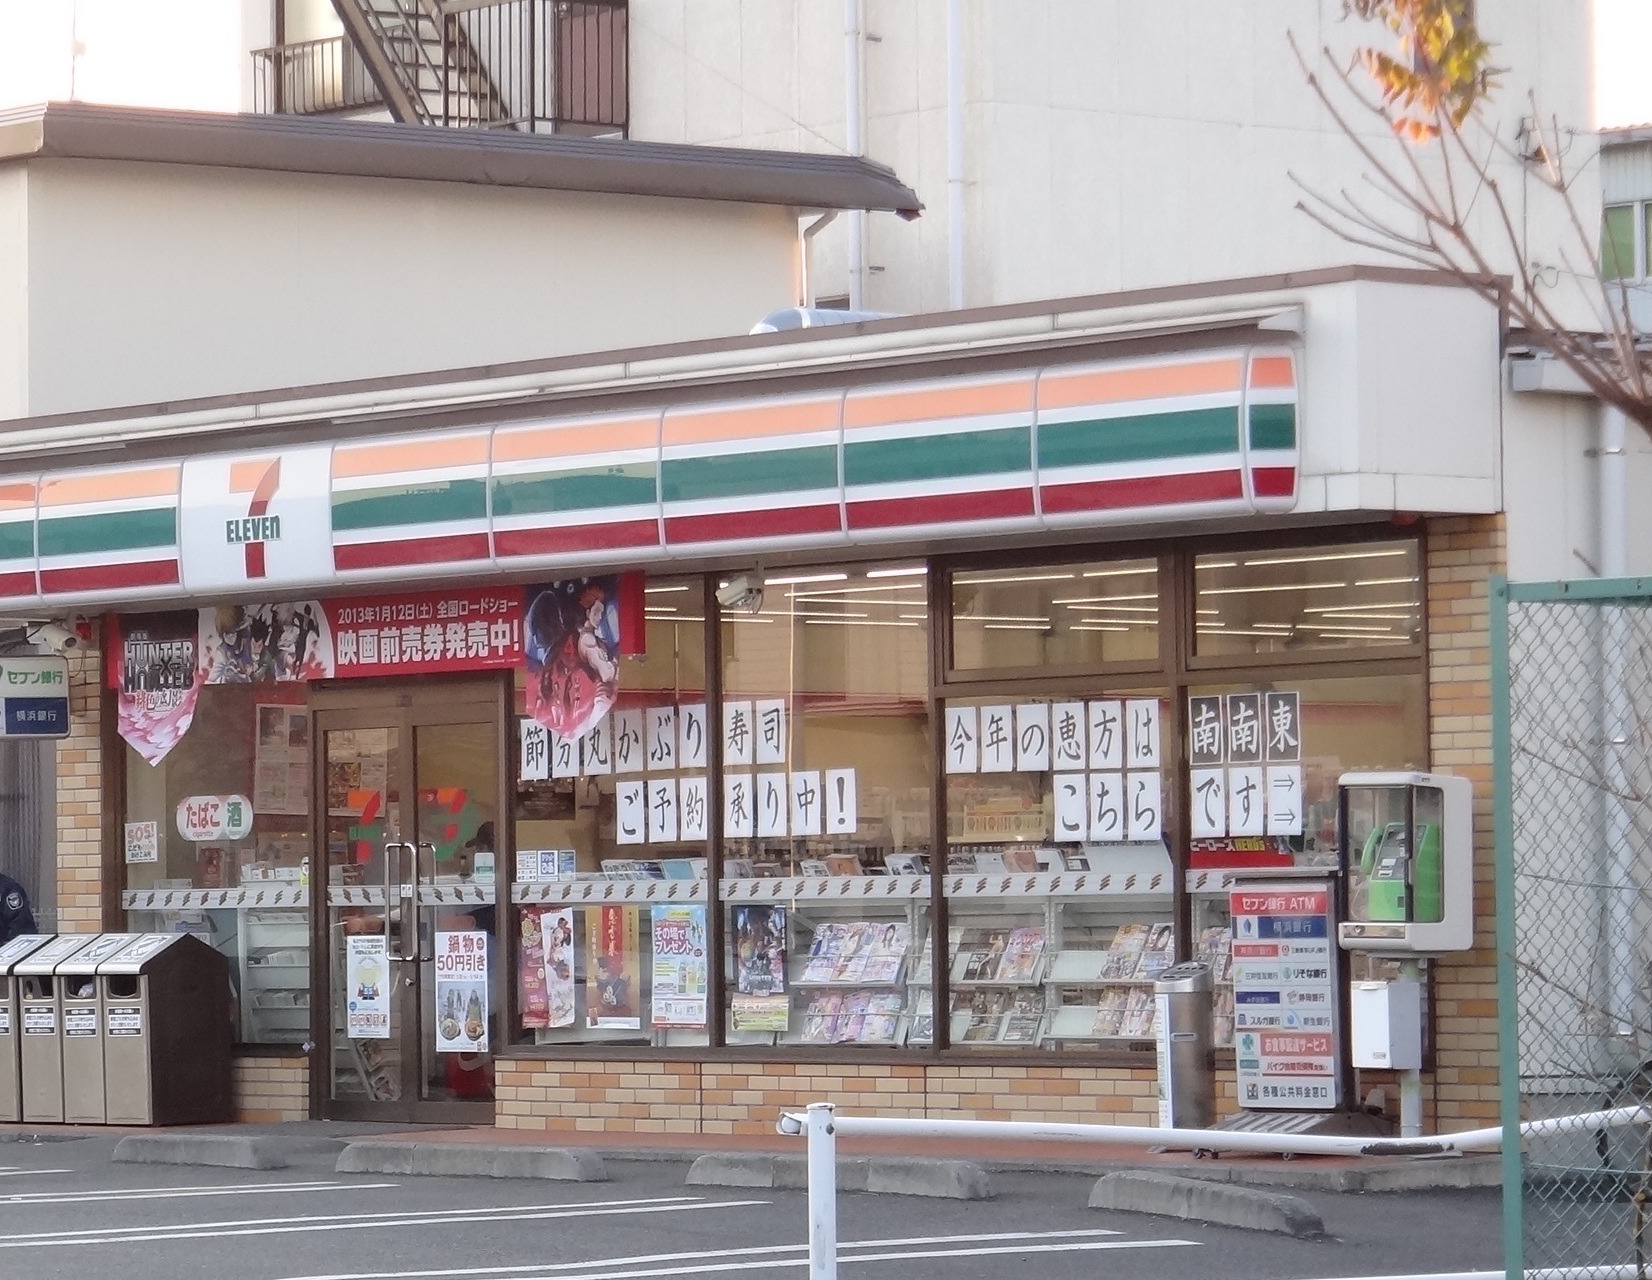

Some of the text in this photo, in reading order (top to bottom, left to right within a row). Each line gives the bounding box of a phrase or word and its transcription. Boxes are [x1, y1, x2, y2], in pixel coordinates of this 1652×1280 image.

[338, 598, 518, 624] 2013年1月12日(土) 全国ロードショー
[337, 618, 519, 665] 映画前売券発売中!
[124, 641, 193, 668] HUNTER
[7, 670, 63, 684] セブン銀行
[16, 710, 57, 721] 横浜銀行
[1192, 700, 1298, 755] 南南東
[950, 709, 1153, 764] 今年の恵方は
[1061, 781, 1155, 833] こちら
[1196, 776, 1257, 828] です
[186, 801, 243, 829] たばこ 酒
[1241, 897, 1316, 911] セブン銀行 ATM
[655, 927, 685, 940] その場で
[448, 935, 474, 954] 鍋物
[655, 940, 693, 954] プレゼント
[437, 955, 486, 971] 50円引き
[1293, 968, 1327, 979] りそな銀行
[1250, 1016, 1280, 1026] スルガ銀行
[1262, 1086, 1328, 1098] 各種公共料金窓口
